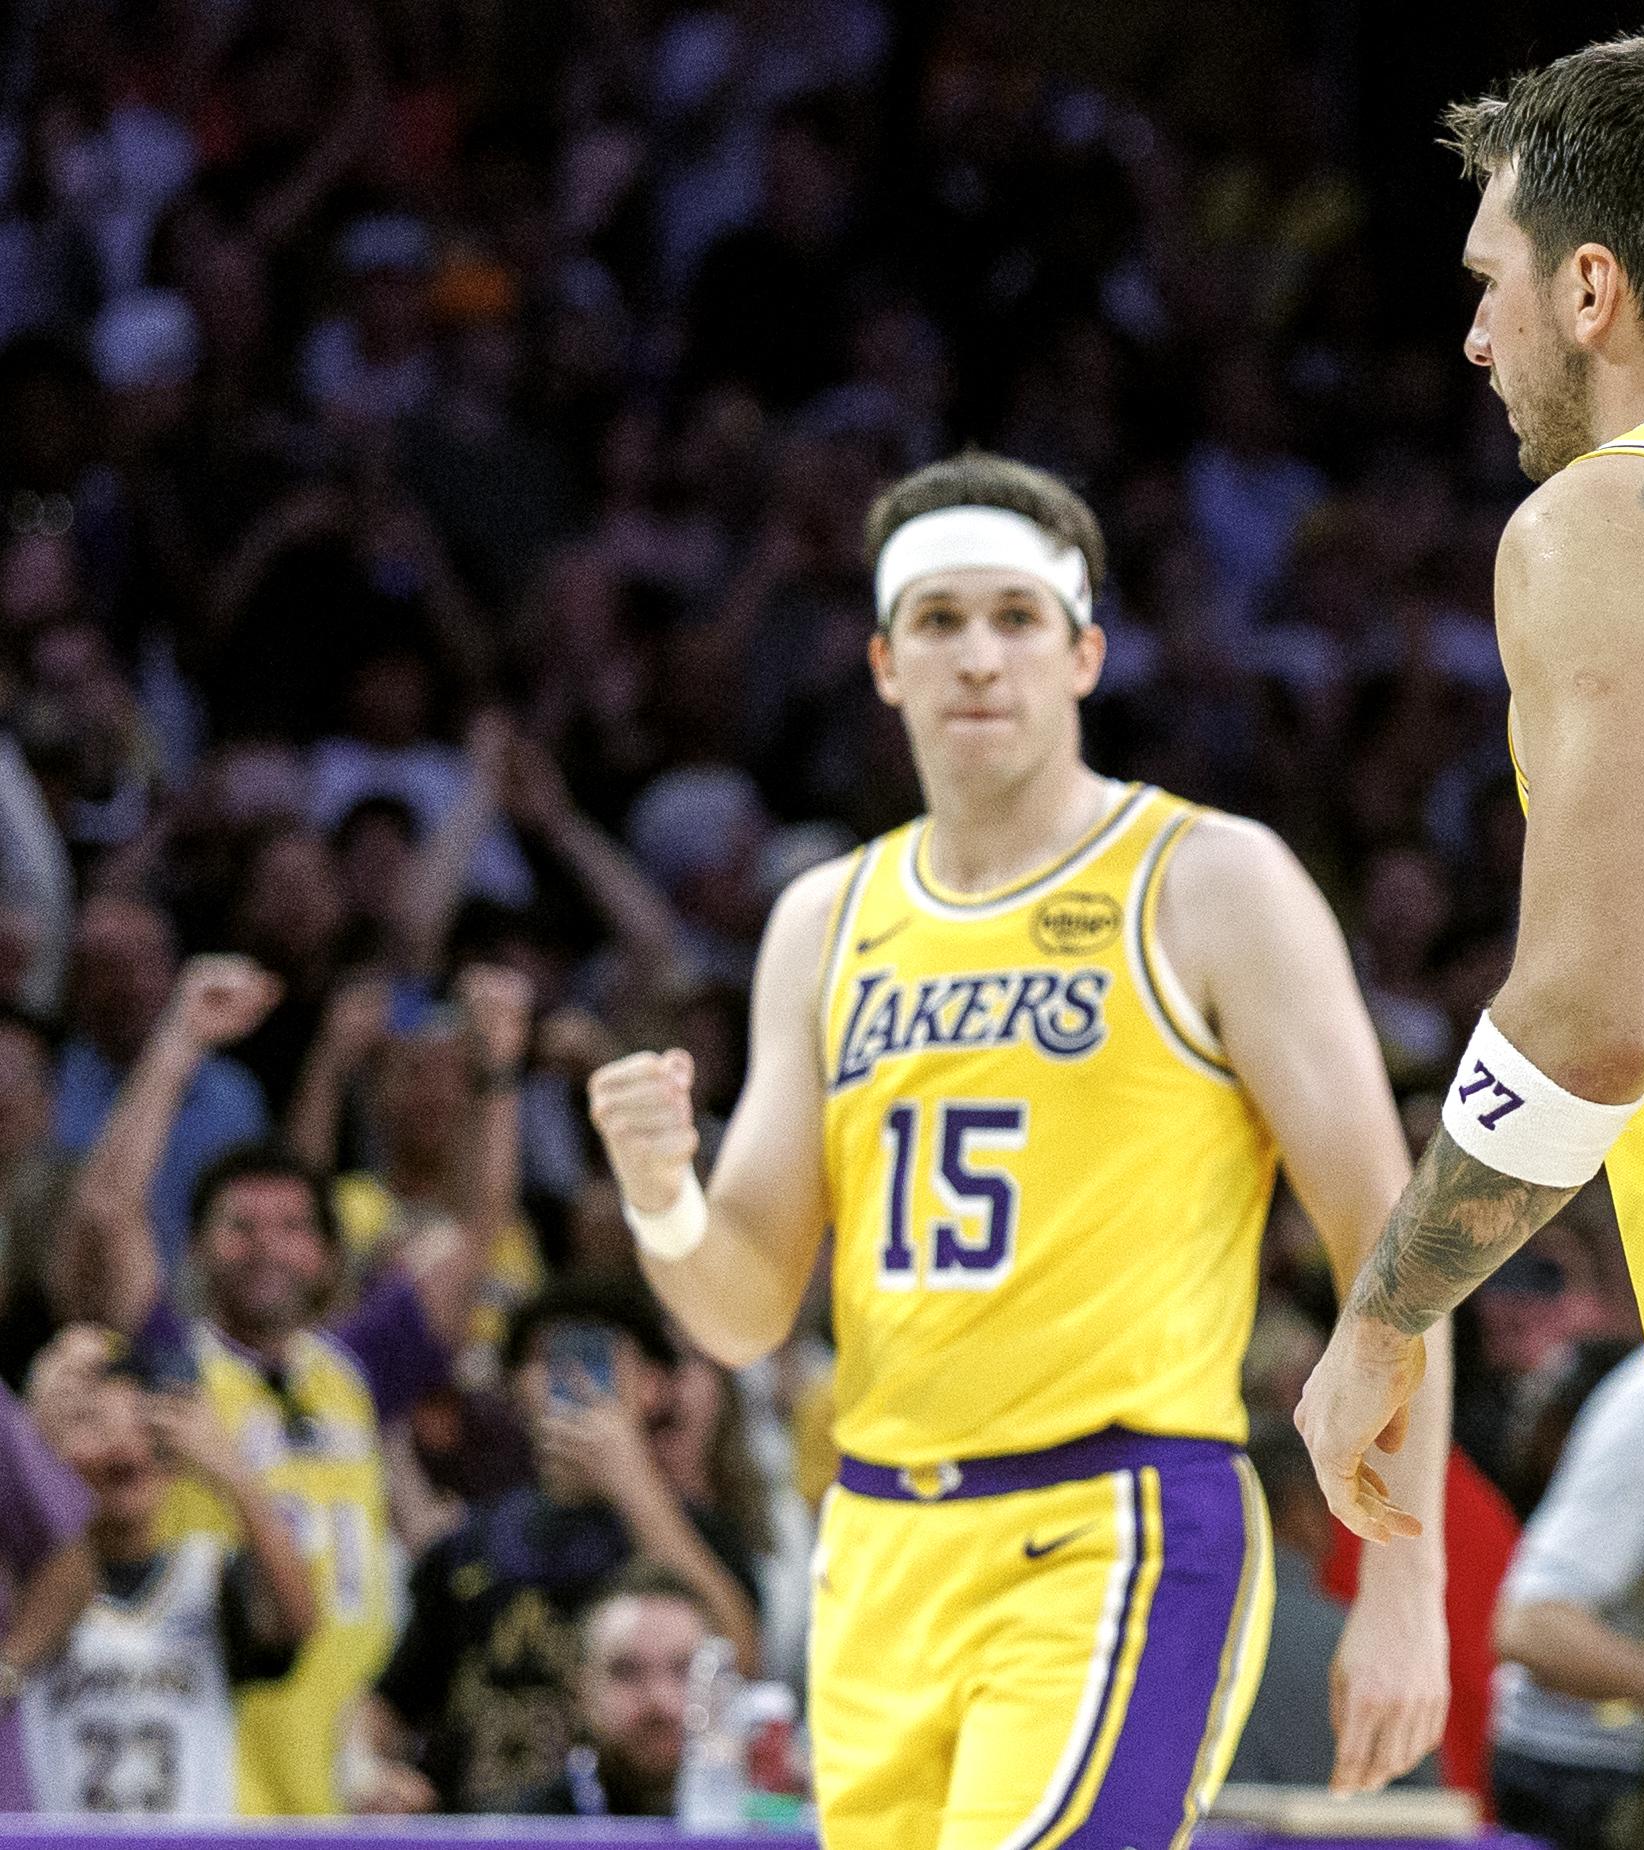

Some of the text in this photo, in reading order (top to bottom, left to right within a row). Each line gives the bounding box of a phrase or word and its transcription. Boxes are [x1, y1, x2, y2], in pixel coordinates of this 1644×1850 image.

[832, 965, 1111, 1092] LAKERS
[1459, 1059, 1525, 1131] 77
[876, 1100, 1027, 1290] 15
[76, 1717, 180, 1812] 23
